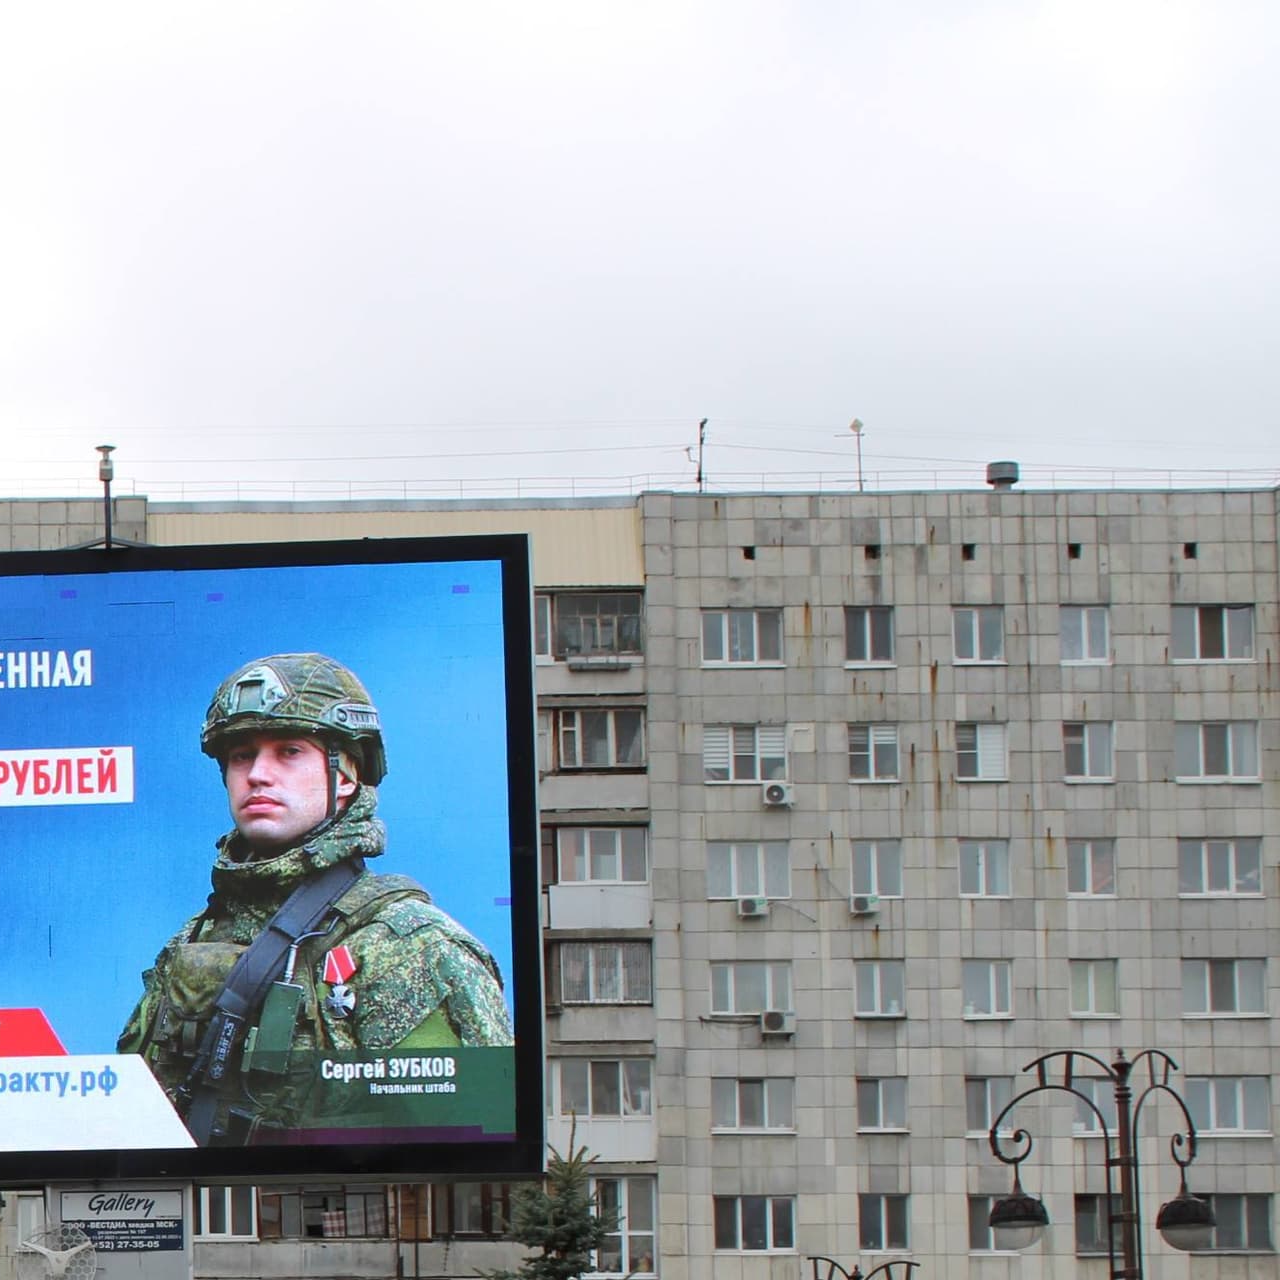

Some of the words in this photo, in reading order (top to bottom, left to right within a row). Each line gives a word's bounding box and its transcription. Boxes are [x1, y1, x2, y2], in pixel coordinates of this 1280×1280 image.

[321, 1058, 385, 1083] Сергей
[388, 1056, 456, 1078] ЗУБКОВ
[369, 1083, 424, 1095] Начальник
[425, 1081, 456, 1093] штаба
[88, 1193, 156, 1218] Gallery
